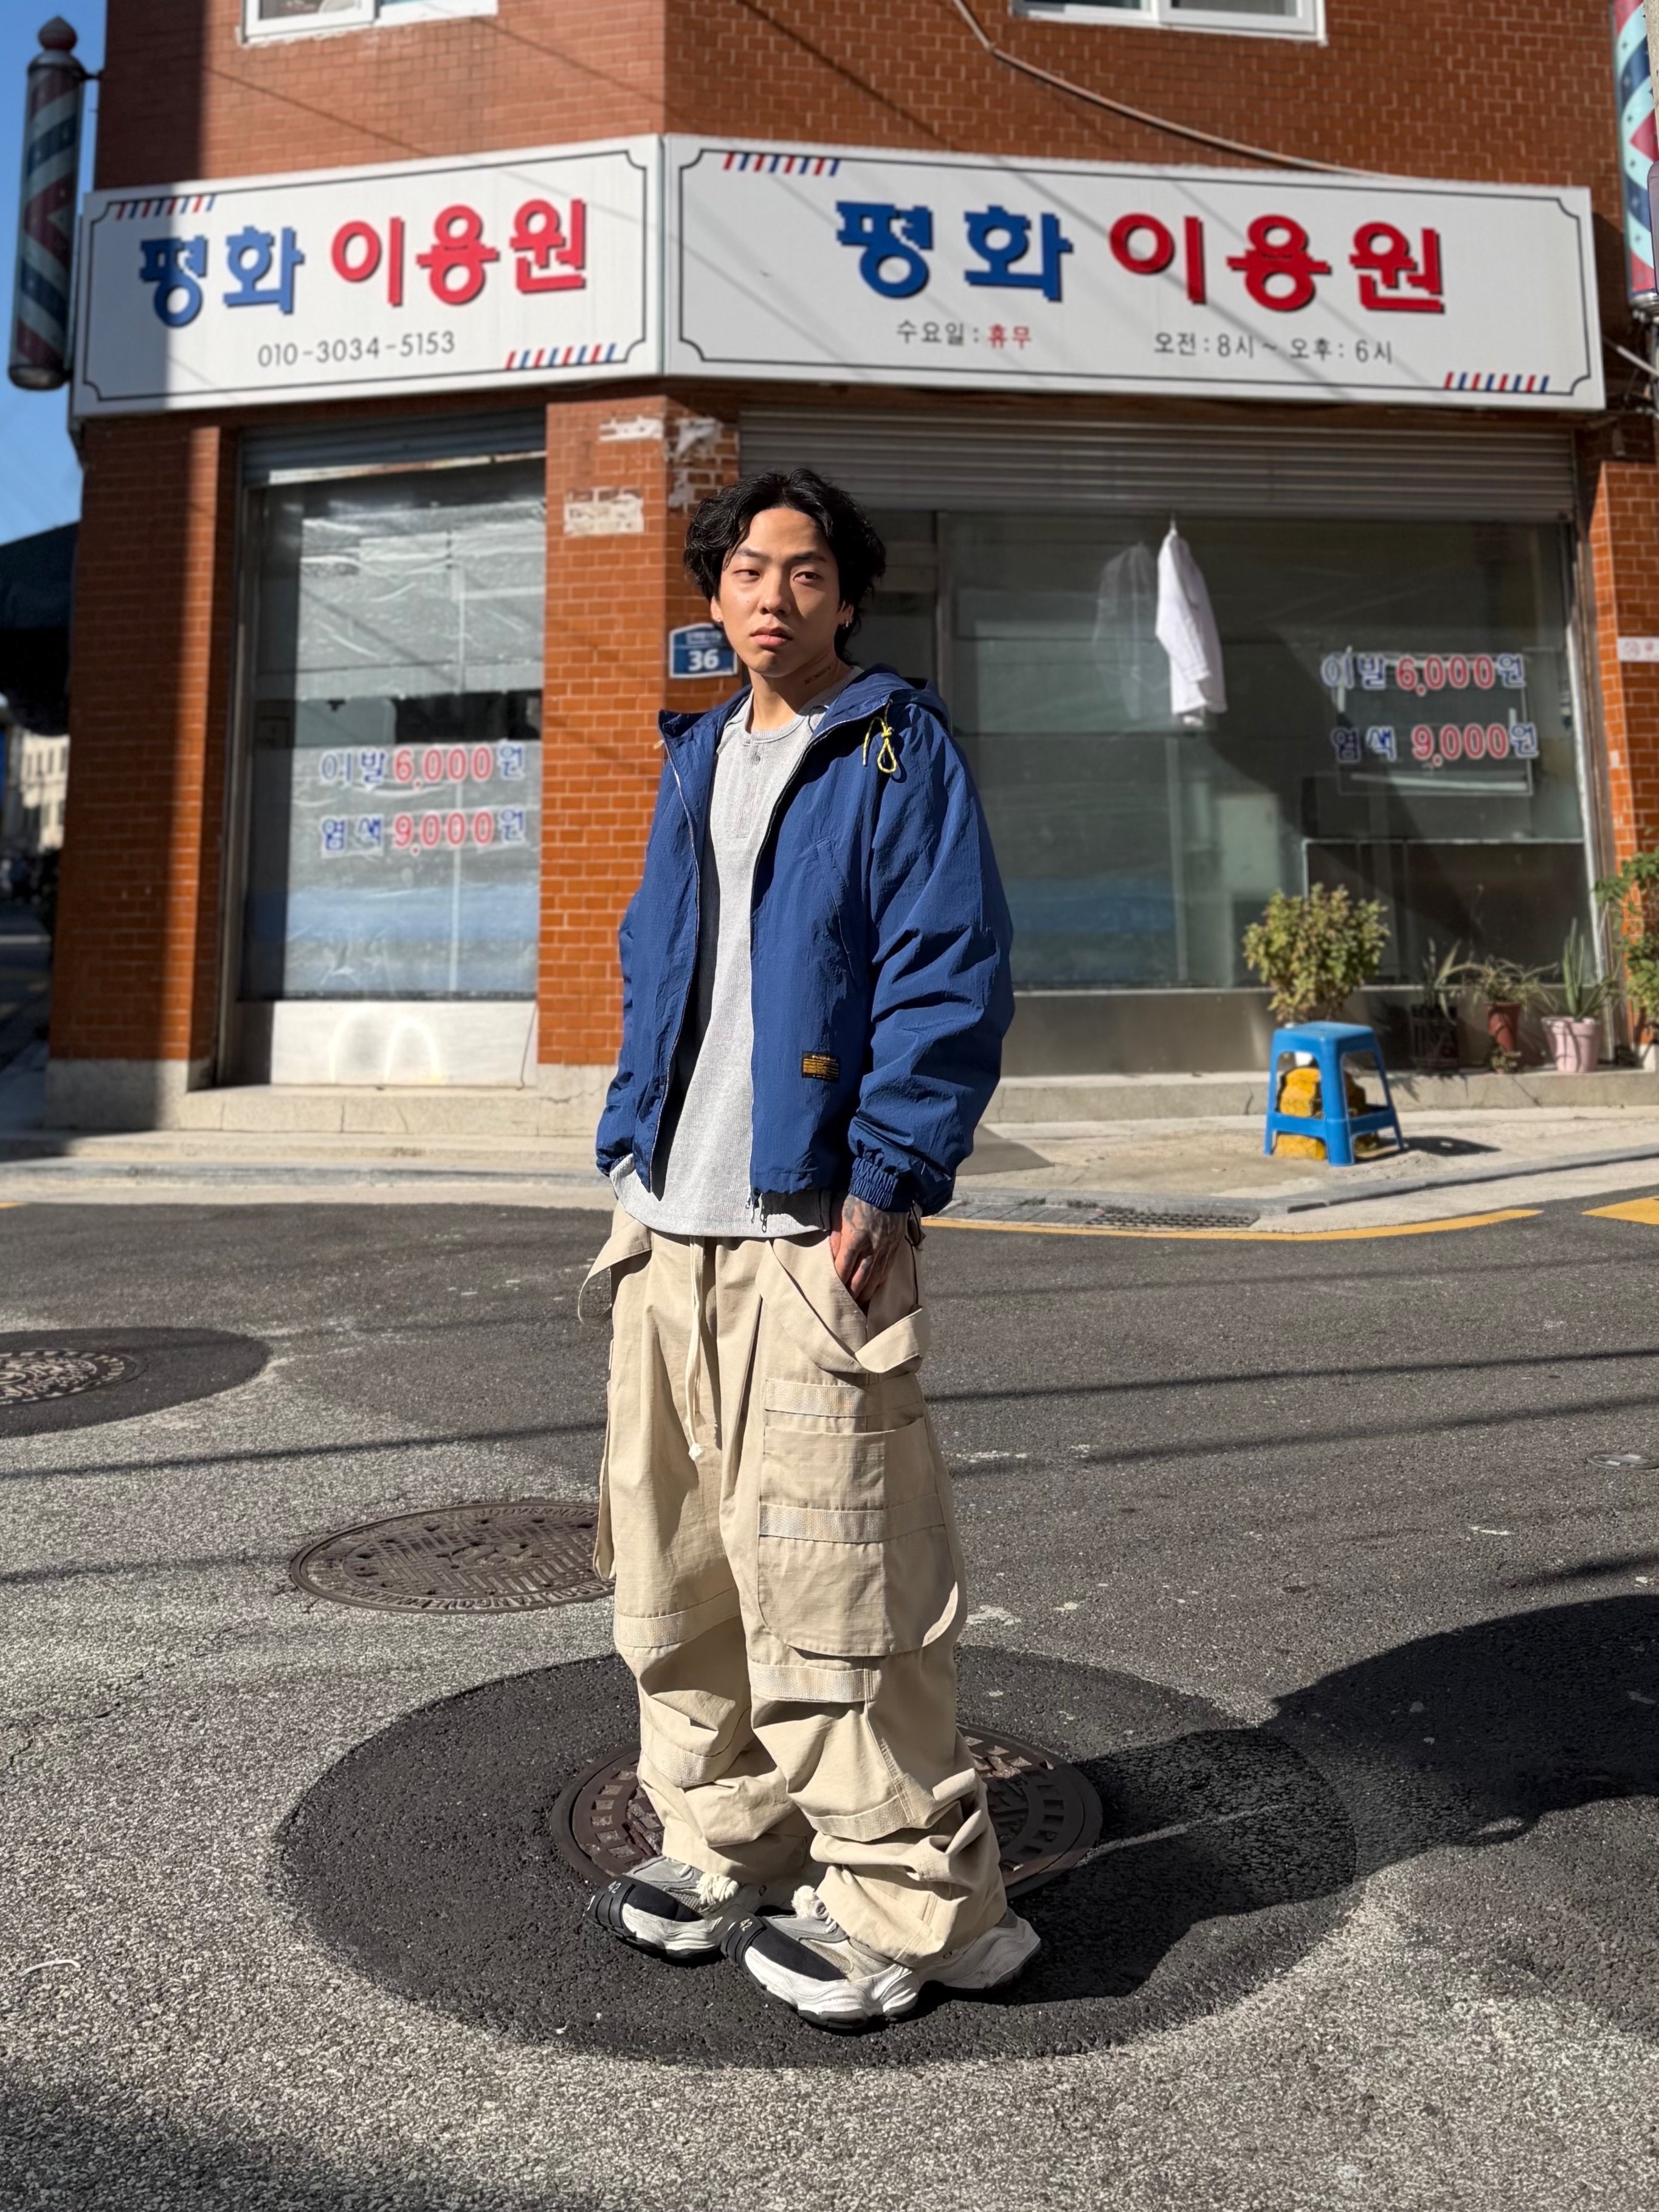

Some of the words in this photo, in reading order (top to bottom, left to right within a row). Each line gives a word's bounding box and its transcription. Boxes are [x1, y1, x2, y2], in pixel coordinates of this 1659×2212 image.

[139, 225, 305, 328] 평화
[331, 198, 586, 307] 이용원
[835, 201, 1074, 304] 평화
[1109, 212, 1445, 314] 이용원
[258, 331, 455, 368] 010-3034-5153
[688, 649, 720, 672] 36
